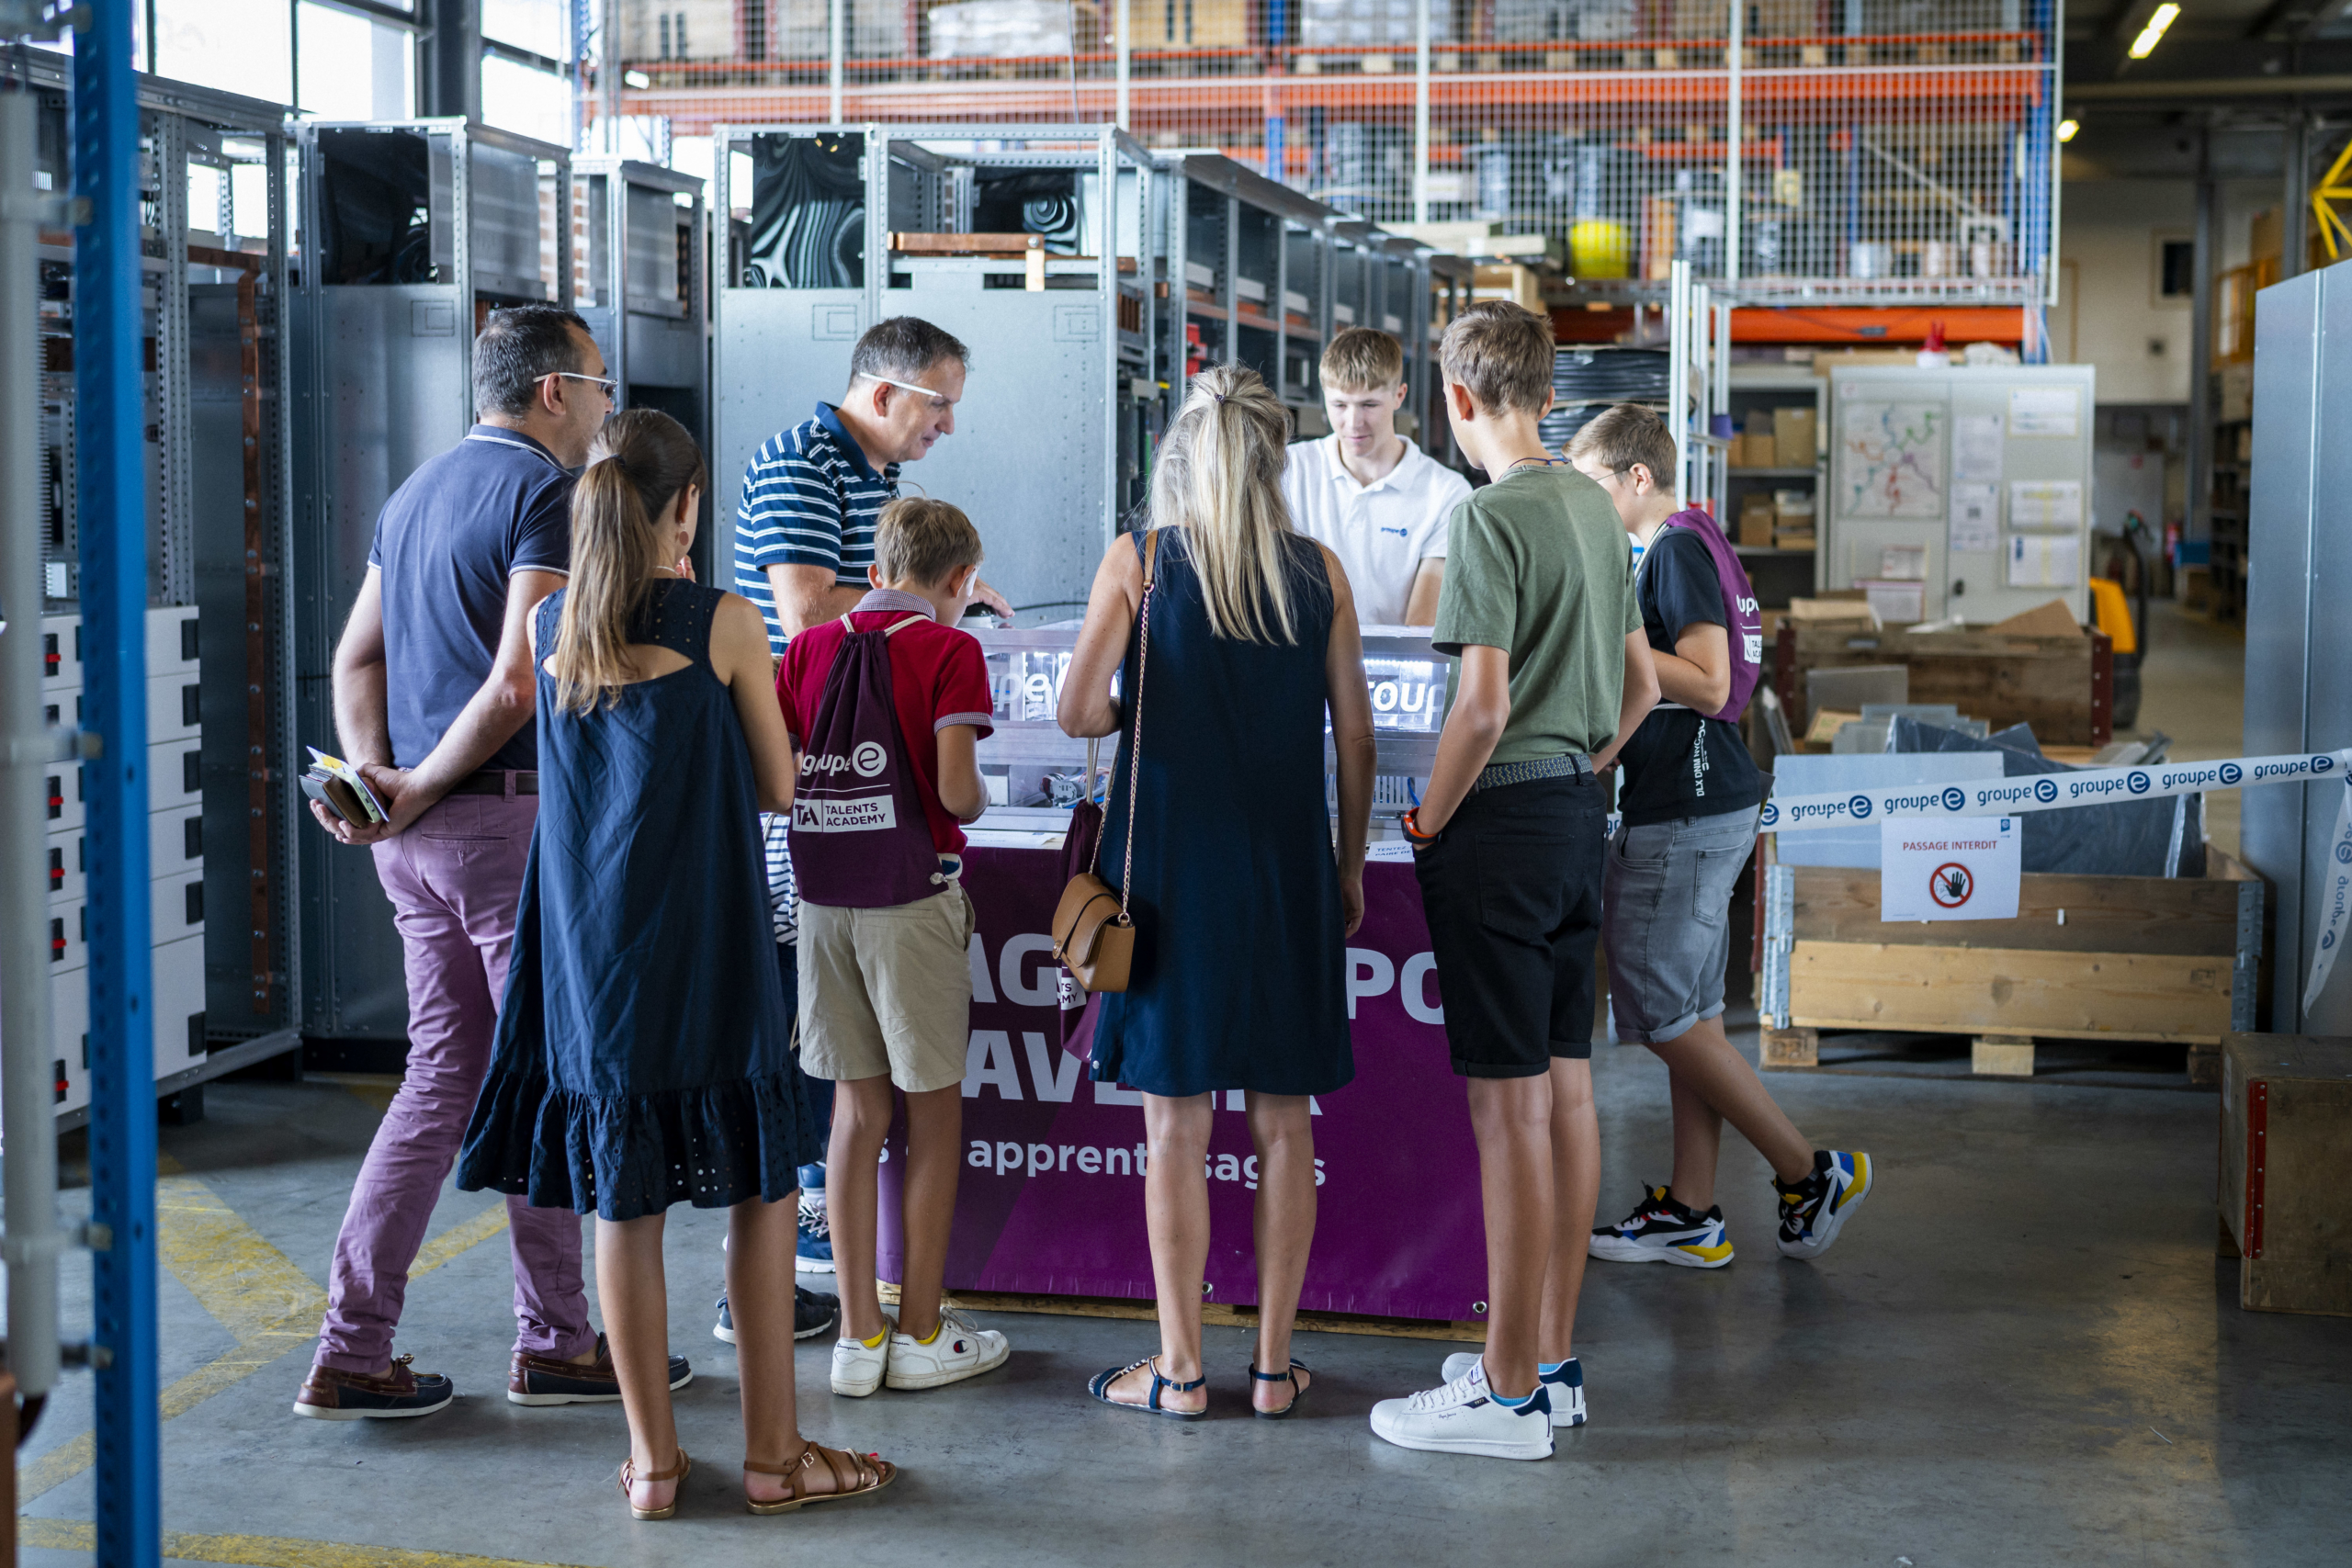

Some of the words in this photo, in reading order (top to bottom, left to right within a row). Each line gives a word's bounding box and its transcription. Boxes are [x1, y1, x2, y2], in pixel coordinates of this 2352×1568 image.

[1693, 758, 1703, 778] DNM
[1695, 779, 1705, 797] DLX
[1792, 802, 1847, 822] groupe
[1884, 795, 1939, 815] groupe
[1977, 786, 2032, 807] groupe
[2070, 778, 2125, 798] groupe
[2162, 770, 2217, 789] groupe
[2254, 761, 2309, 780] groupe
[825, 802, 878, 815] TALENTS
[826, 813, 887, 827] ACADEMY
[1902, 841, 1949, 851] PASSAGE
[1951, 840, 1997, 851] INTERDIT
